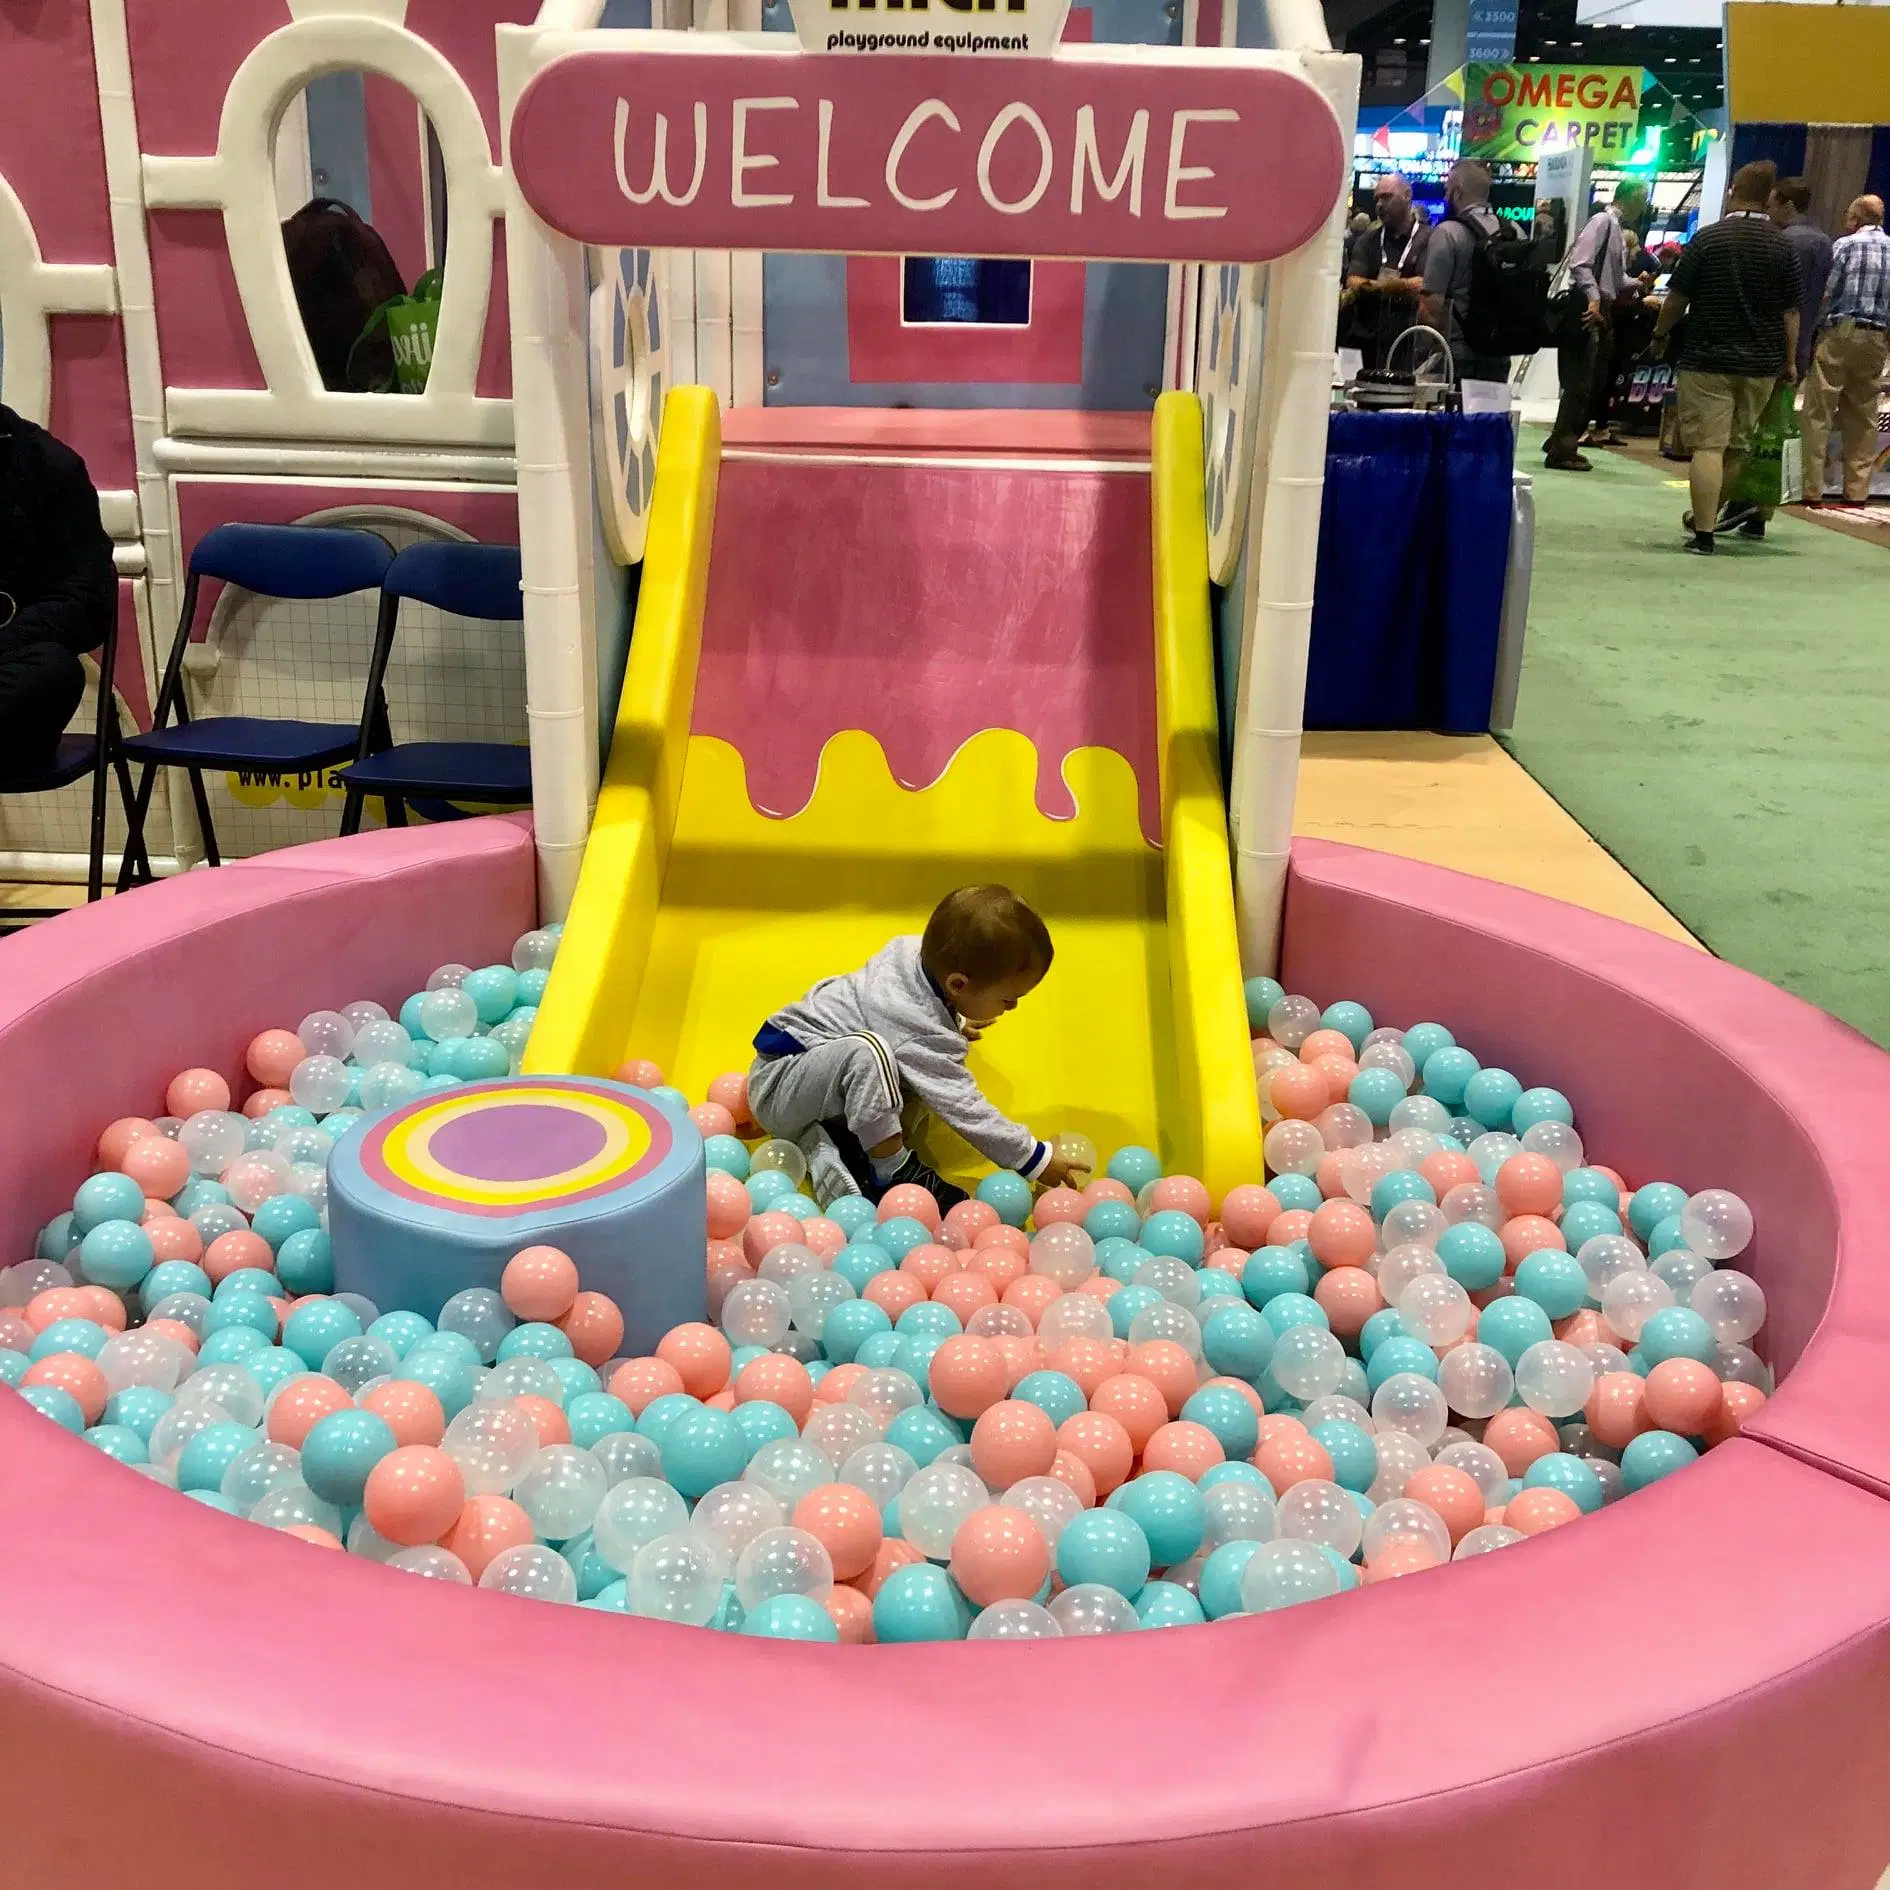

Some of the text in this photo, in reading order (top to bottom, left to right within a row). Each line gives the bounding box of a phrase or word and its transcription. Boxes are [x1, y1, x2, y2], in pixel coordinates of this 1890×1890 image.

[827, 30, 1029, 52] playground equipment
[1484, 71, 1638, 109] OMEGA
[1515, 119, 1634, 148] CARPET
[614, 96, 1241, 219] WELCOME
[239, 769, 346, 791] www.pla
